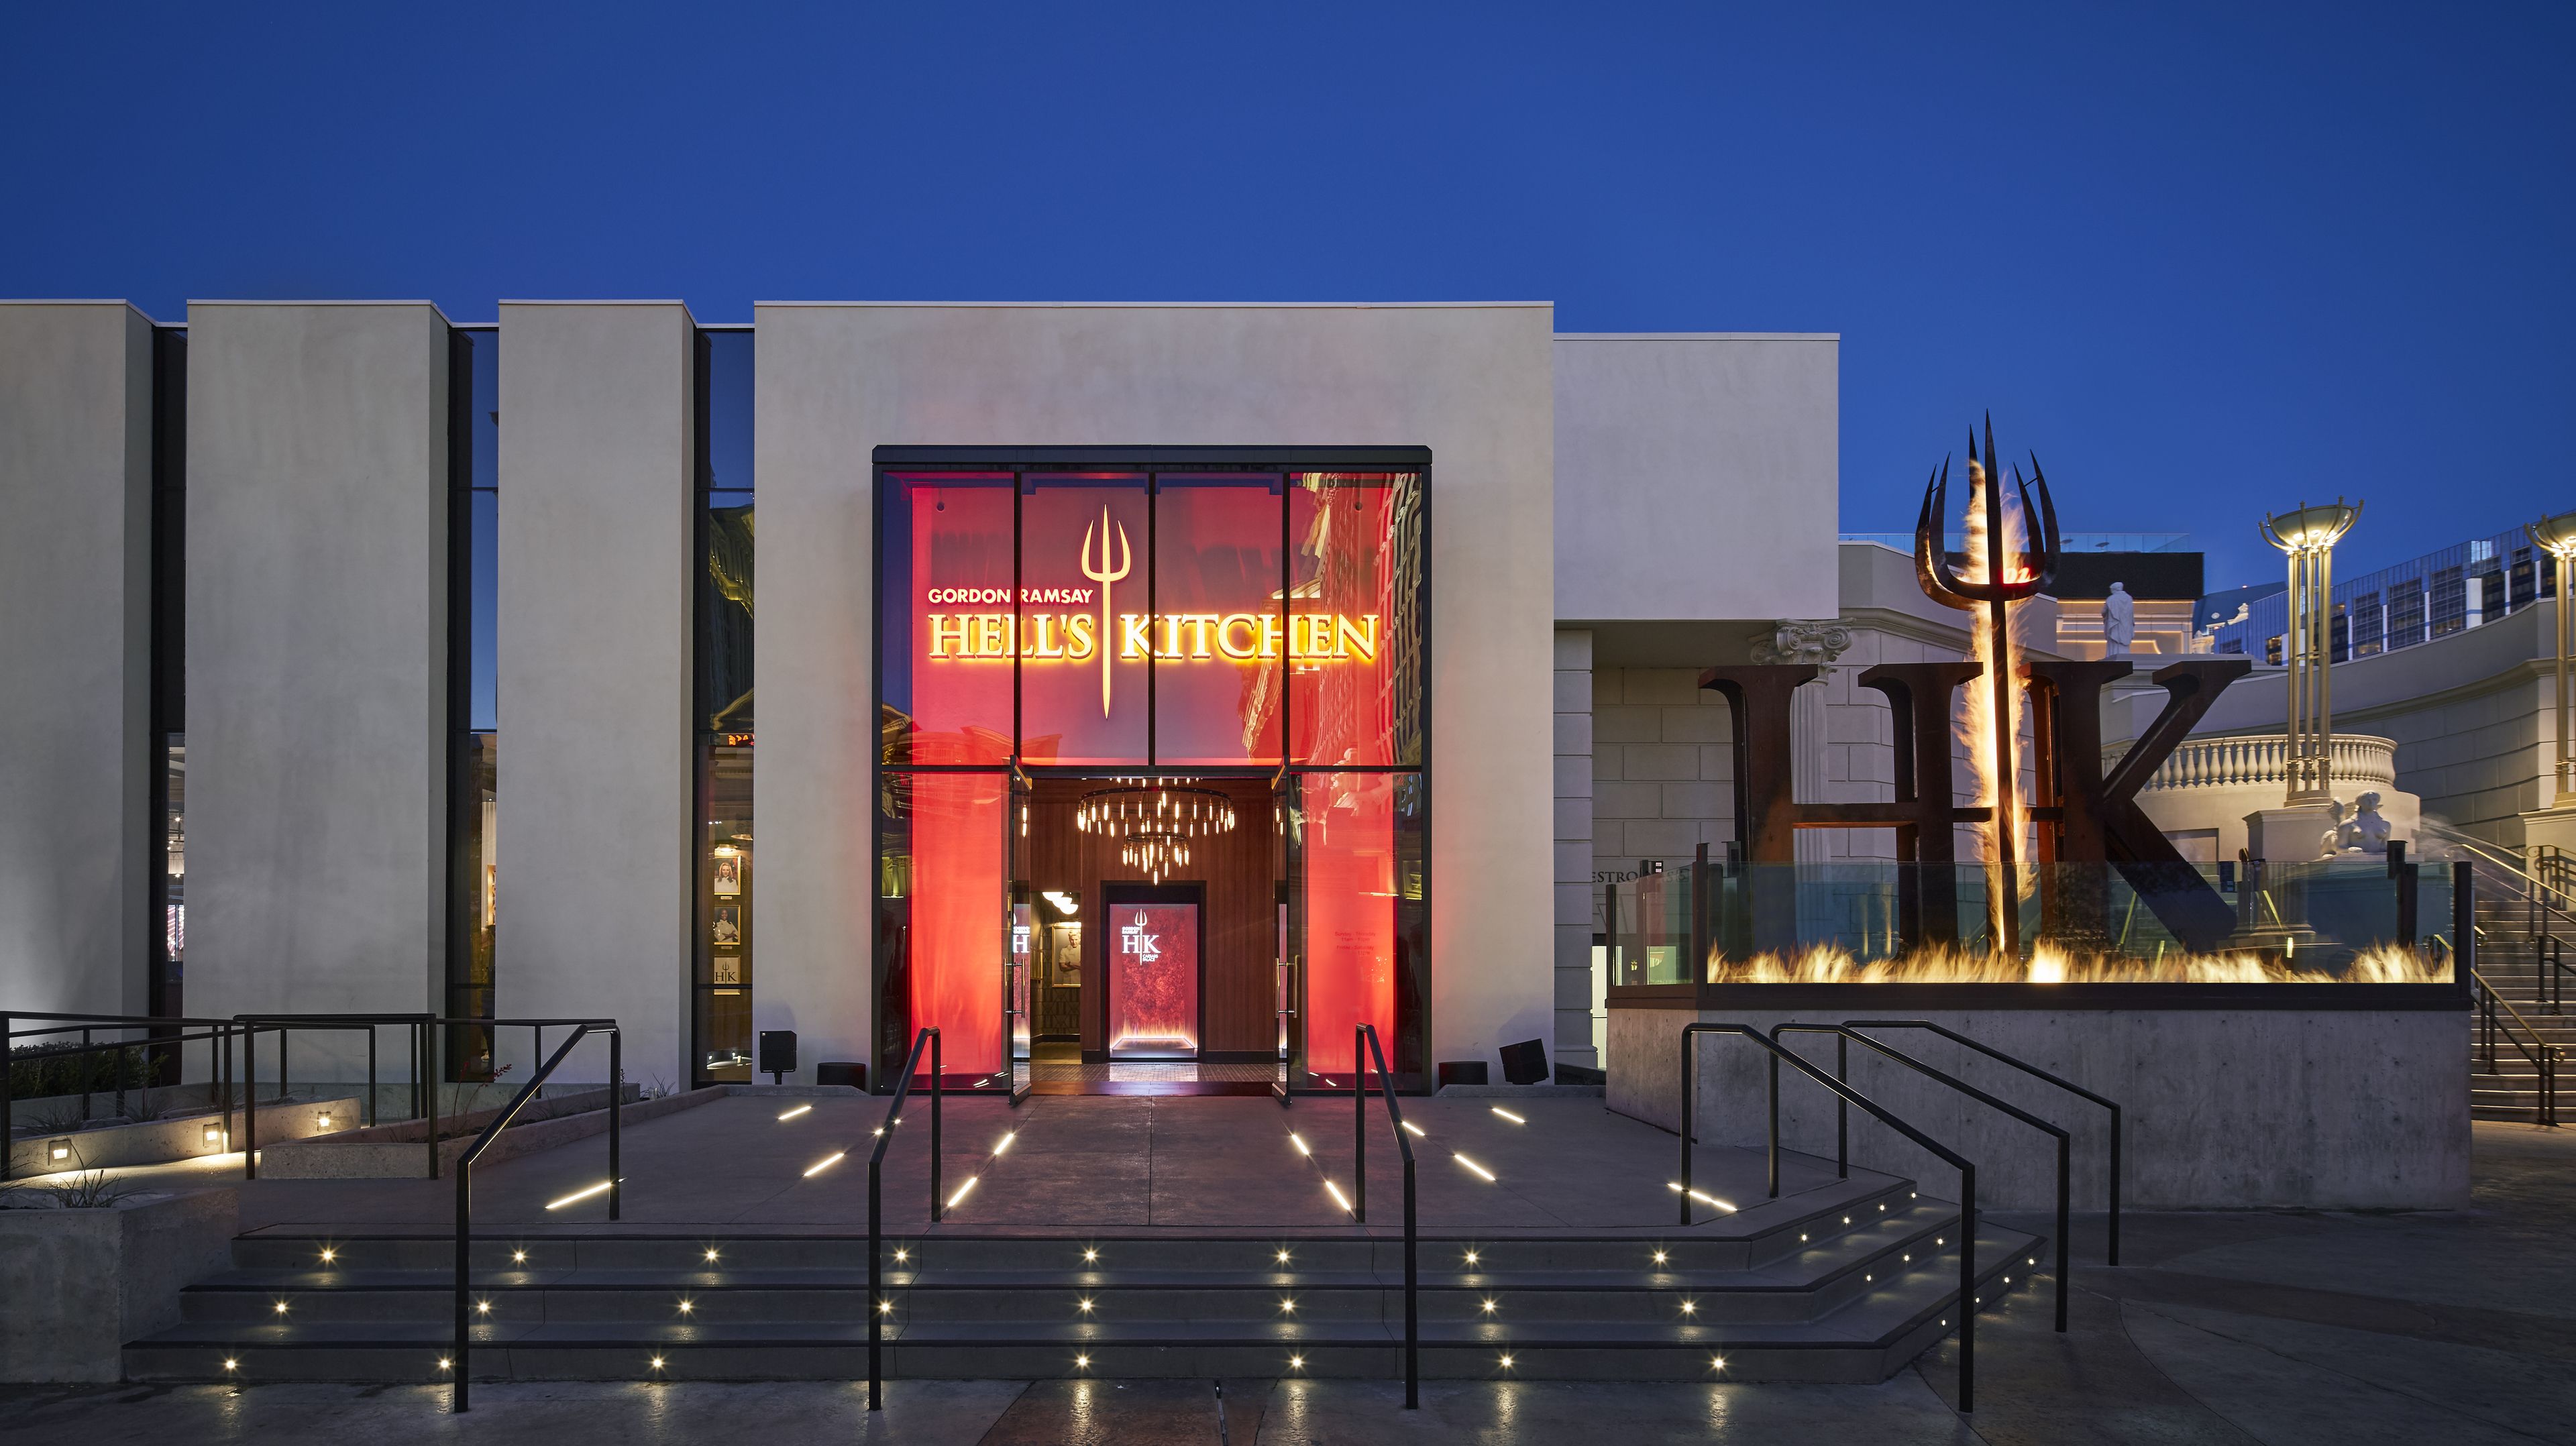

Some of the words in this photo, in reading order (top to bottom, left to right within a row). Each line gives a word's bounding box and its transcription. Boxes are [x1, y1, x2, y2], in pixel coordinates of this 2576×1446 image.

[928, 588, 1011, 604] GORDON
[1021, 588, 1093, 604] RAMSAY
[927, 613, 1094, 659] HELL'S
[1120, 613, 1380, 660] KITCHEN
